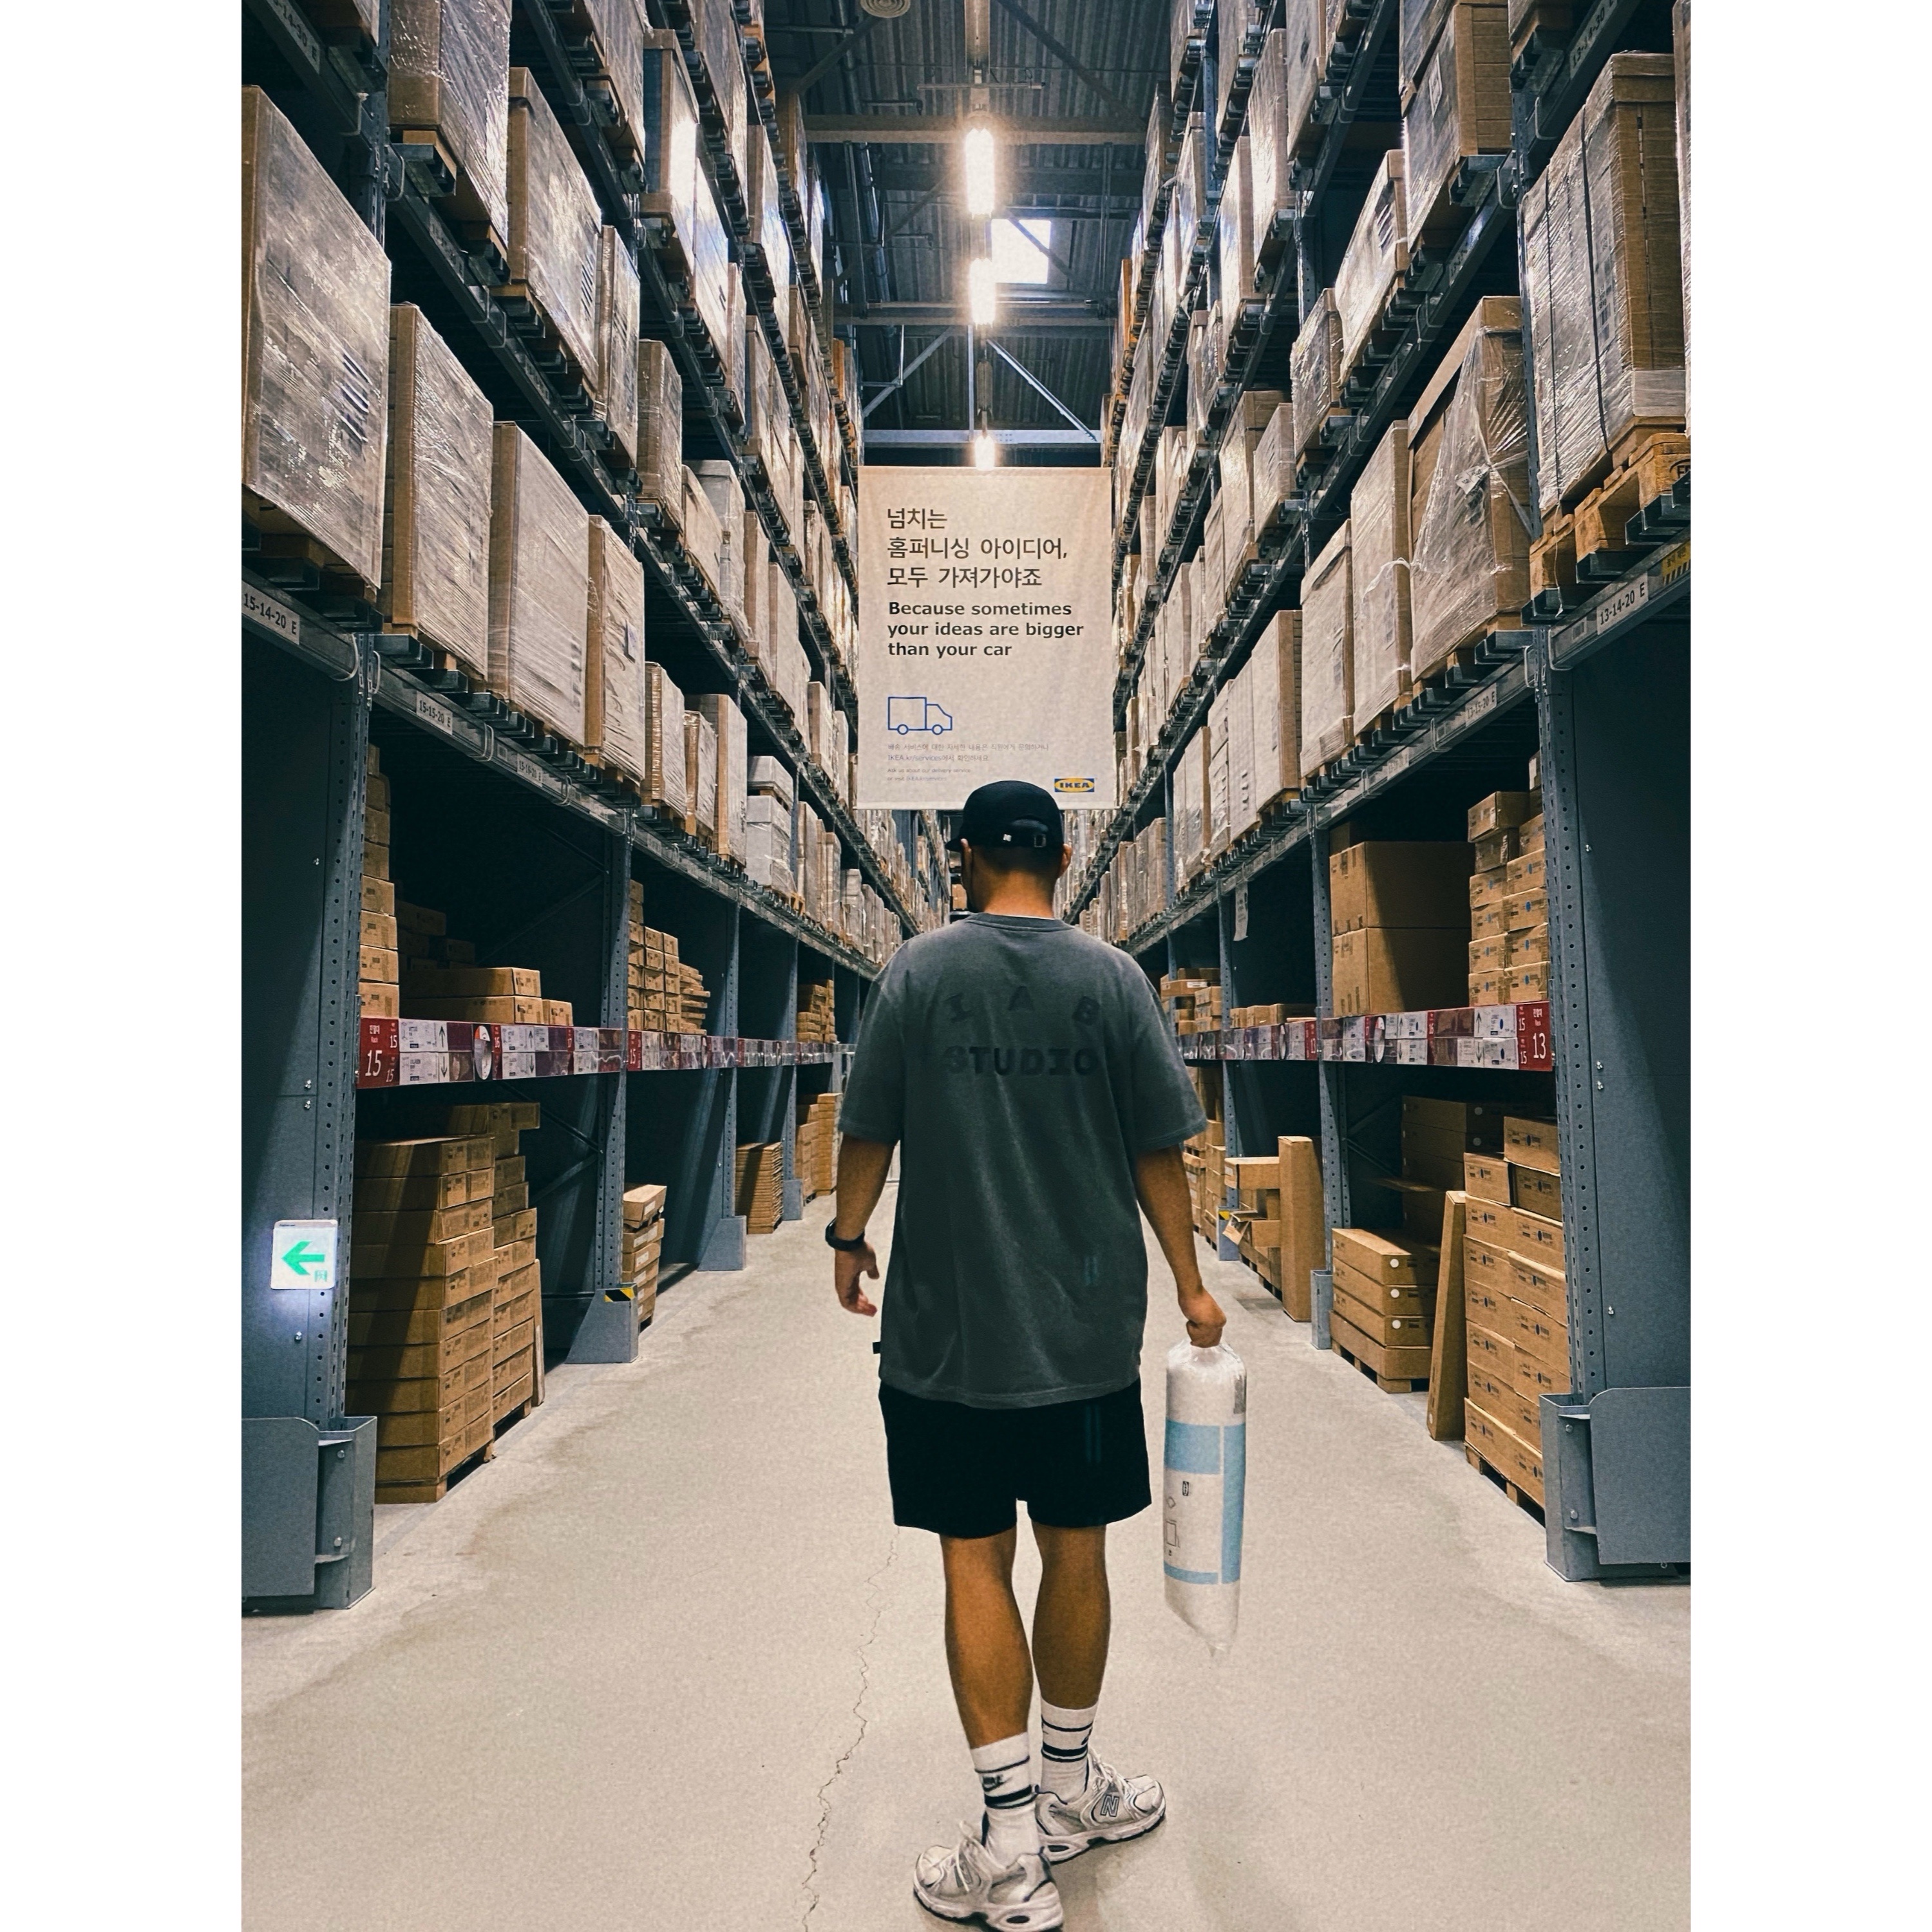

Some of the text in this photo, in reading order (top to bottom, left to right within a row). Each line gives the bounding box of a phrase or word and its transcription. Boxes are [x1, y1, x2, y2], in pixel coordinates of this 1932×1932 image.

[273, 0, 317, 62] -14-30 E
[887, 507, 948, 530] 넘치는
[887, 536, 1068, 560] 홈퍼니싱 아이디어,
[887, 567, 1043, 589] 모두 가져가야죠
[244, 593, 296, 635] 15-14-20 E
[889, 601, 1072, 615] Because sometimes
[1600, 582, 1645, 625] 13-14-20 E
[887, 621, 1084, 639] your ideas are bigger
[887, 642, 1012, 659] than your car
[1492, 691, 1495, 703] E
[419, 700, 451, 728] 15-15-20 E
[1519, 1018, 1525, 1031] 15
[390, 1035, 397, 1048] 15
[1533, 1032, 1546, 1059] 13
[365, 1050, 383, 1077] 15
[630, 1048, 636, 1064] 15
[942, 1045, 1099, 1075] STUDIO
[1520, 1051, 1527, 1064] 15
[386, 1069, 395, 1083] 15
[1101, 1794, 1119, 1817] N
